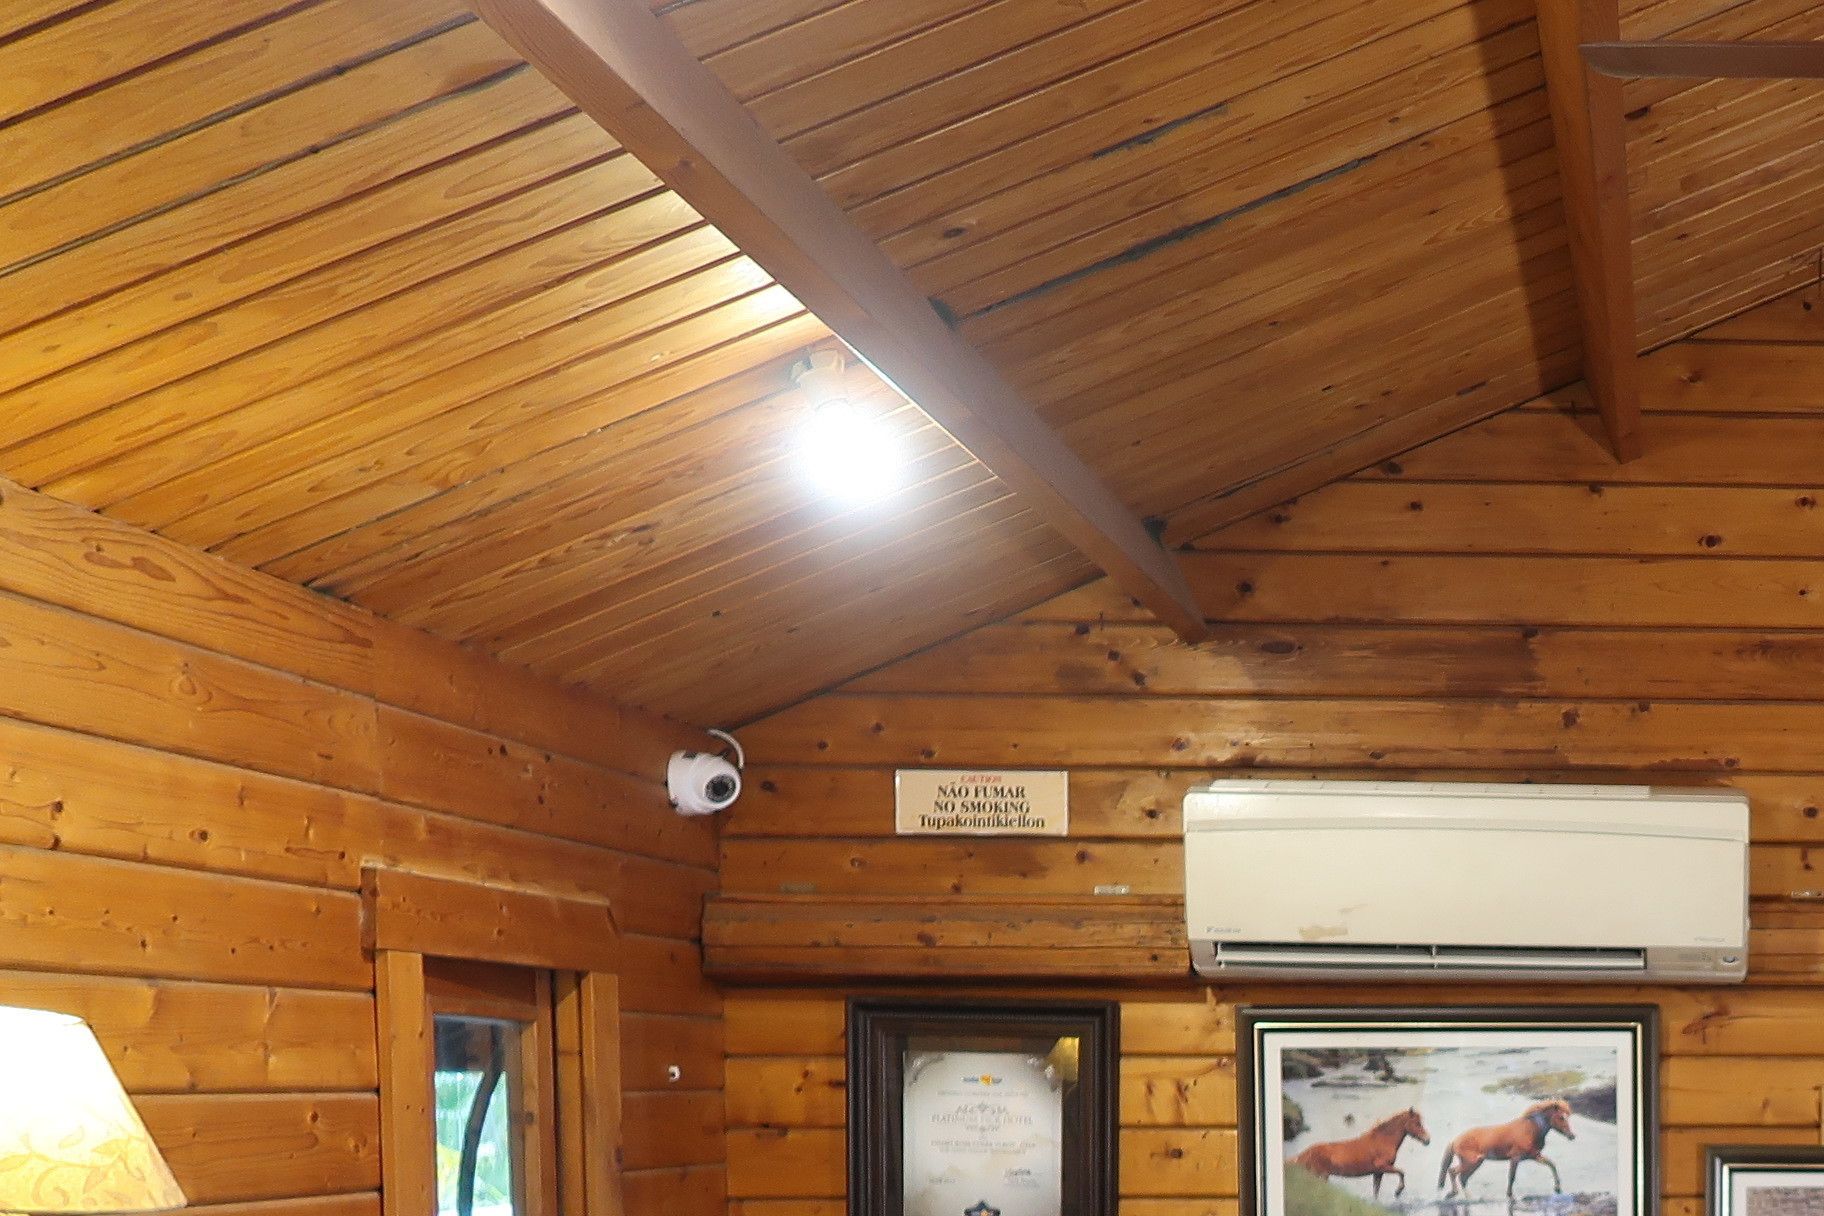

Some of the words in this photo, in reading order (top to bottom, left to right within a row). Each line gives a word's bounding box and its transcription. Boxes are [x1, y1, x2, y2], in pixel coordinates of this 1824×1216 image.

[937, 783, 970, 799] NÃO
[974, 785, 1026, 799] FUMAR
[933, 801, 956, 814] NO
[960, 800, 1031, 814] SMOKING
